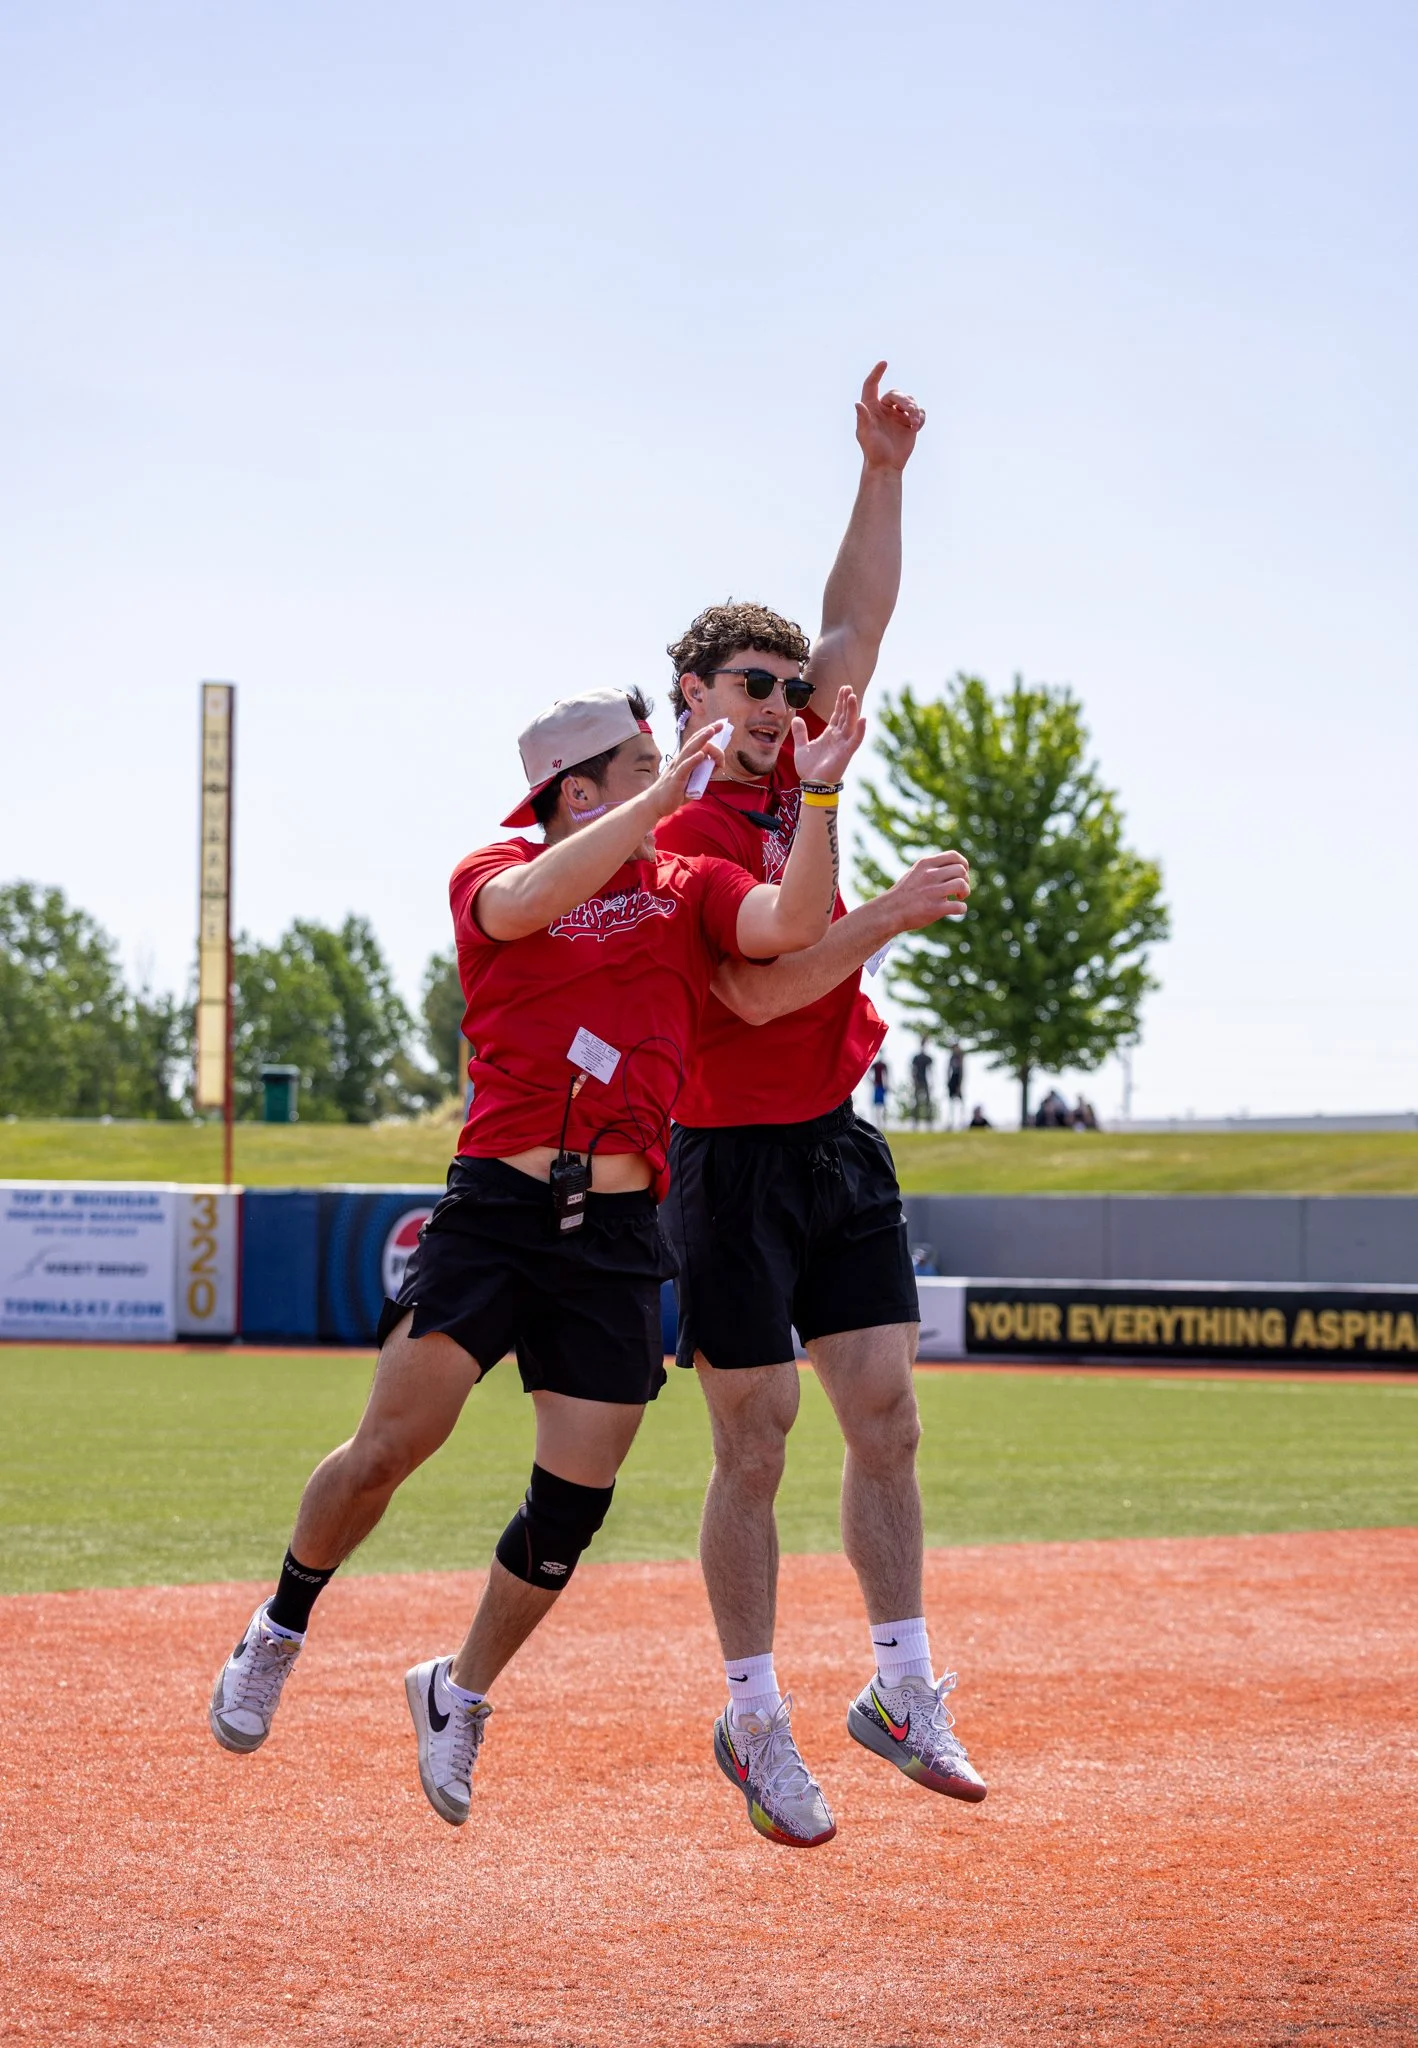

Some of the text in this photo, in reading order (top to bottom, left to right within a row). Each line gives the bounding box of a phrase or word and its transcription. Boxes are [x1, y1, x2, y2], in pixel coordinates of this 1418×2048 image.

[186, 1193, 219, 1320] 320
[968, 1301, 1418, 1352] YOUR EVERYTHING ASPHA
